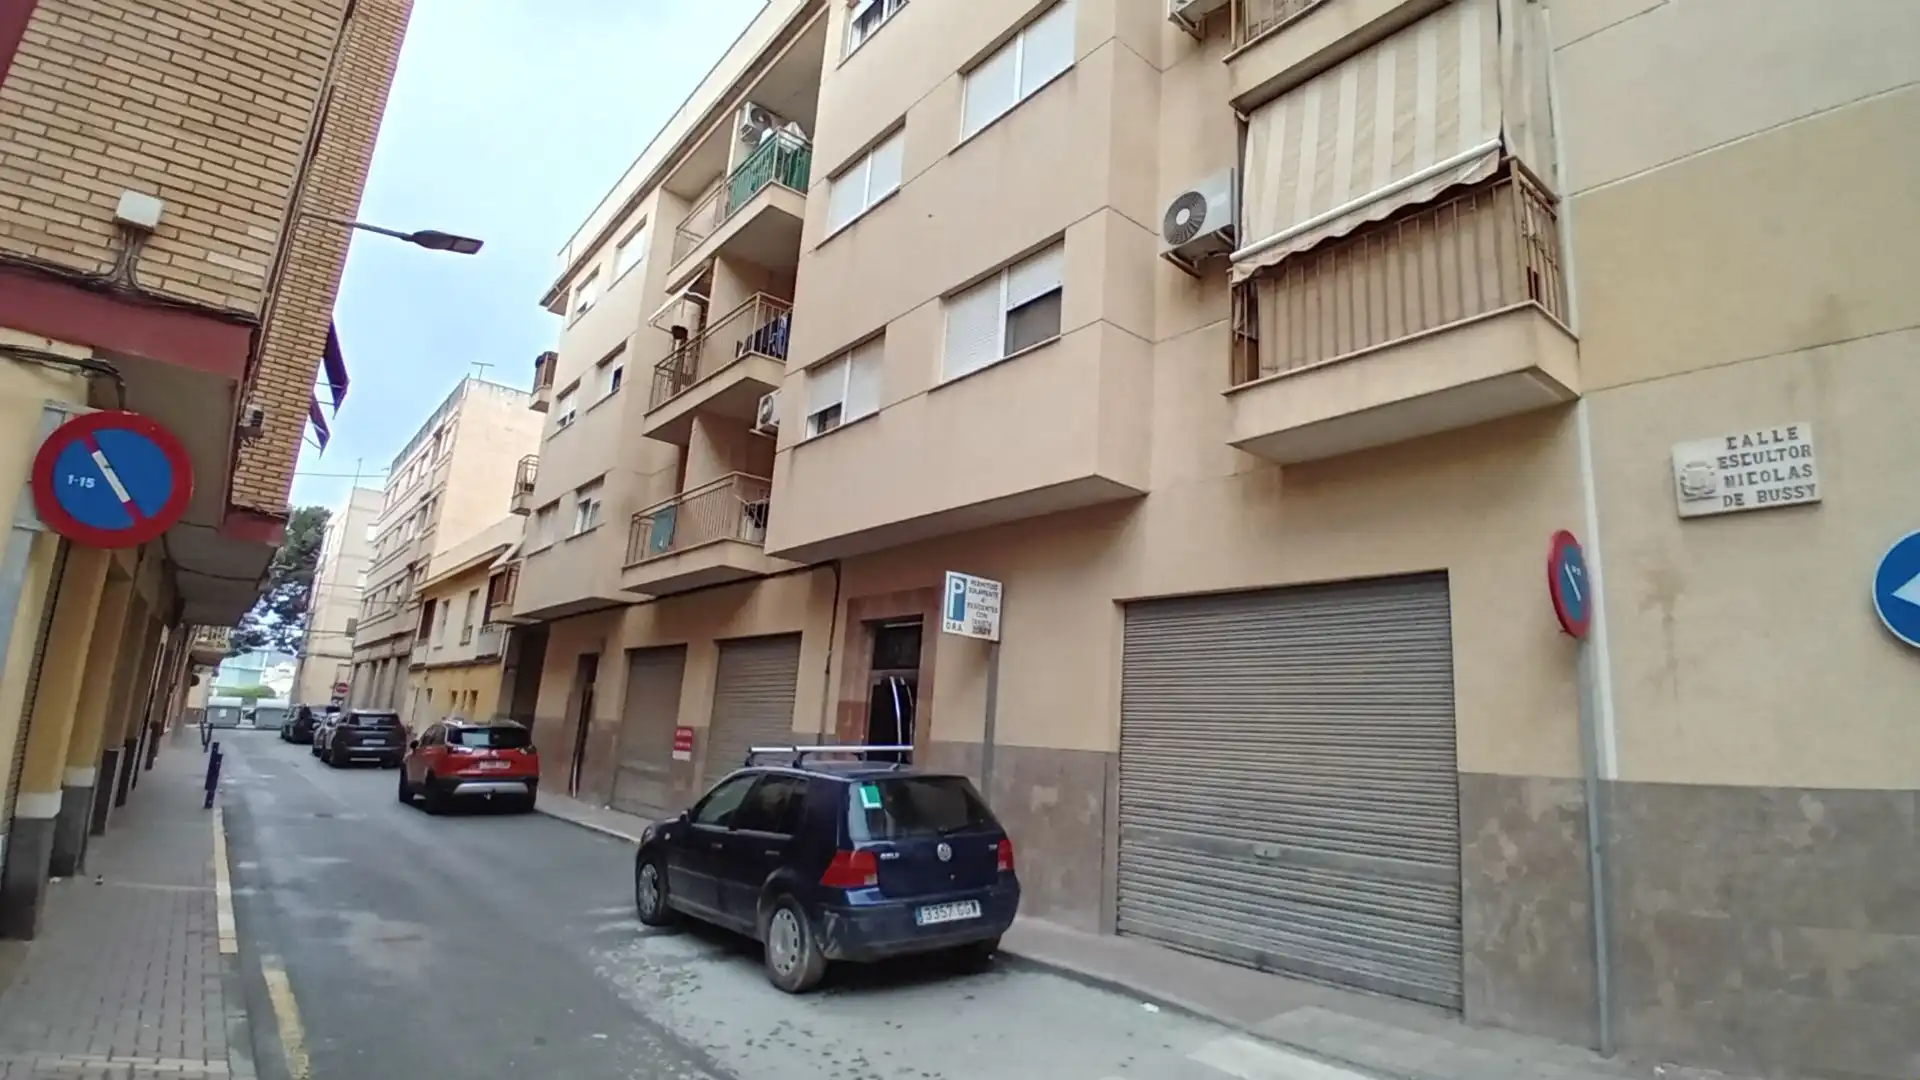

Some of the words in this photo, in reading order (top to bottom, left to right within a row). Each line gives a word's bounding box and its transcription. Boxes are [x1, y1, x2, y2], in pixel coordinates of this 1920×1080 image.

[1725, 426, 1799, 450] CALLE
[1716, 444, 1812, 470] ESCULTOR
[68, 474, 96, 489] 1-15
[1723, 464, 1813, 488] NICOLAS
[1722, 493, 1745, 508] DE
[1755, 483, 1816, 504] BUSSY
[949, 577, 965, 618] P
[924, 905, 952, 920] 3357
